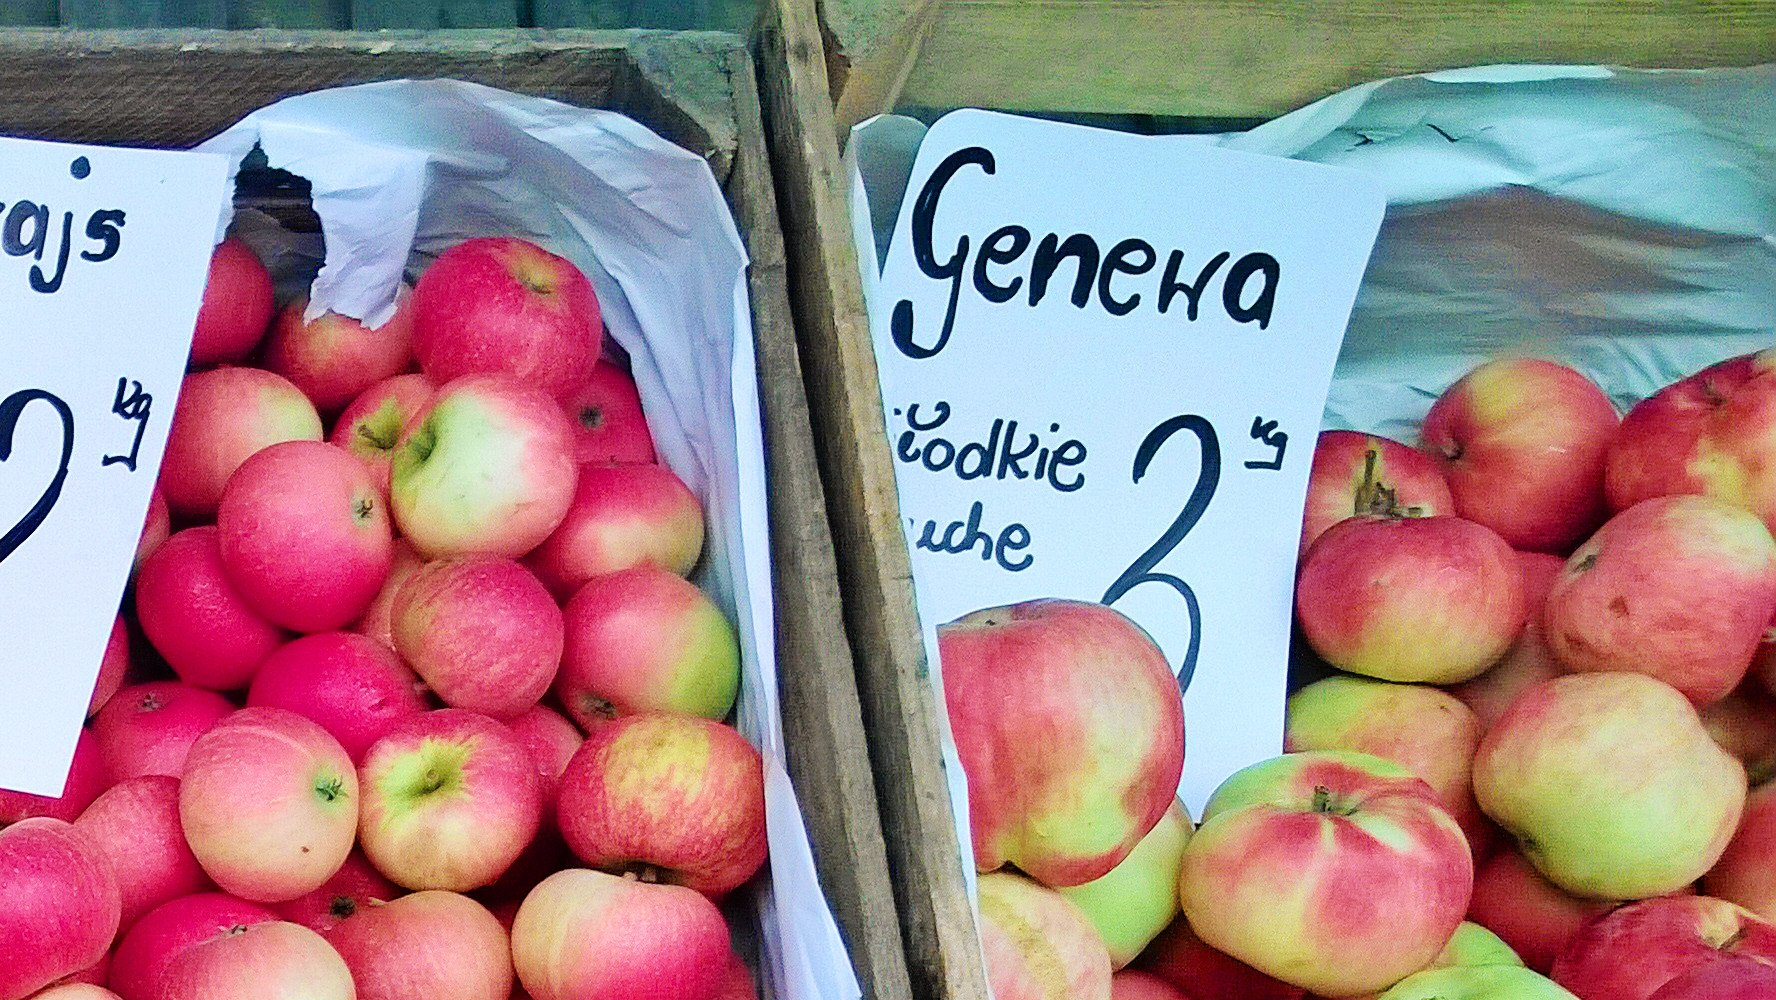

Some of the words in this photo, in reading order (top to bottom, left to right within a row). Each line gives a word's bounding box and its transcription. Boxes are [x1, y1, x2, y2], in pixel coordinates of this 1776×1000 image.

[890, 146, 1282, 359] Genewa
[102, 377, 153, 472] kg
[893, 401, 1087, 492] łodkie
[1244, 415, 1288, 471] kg
